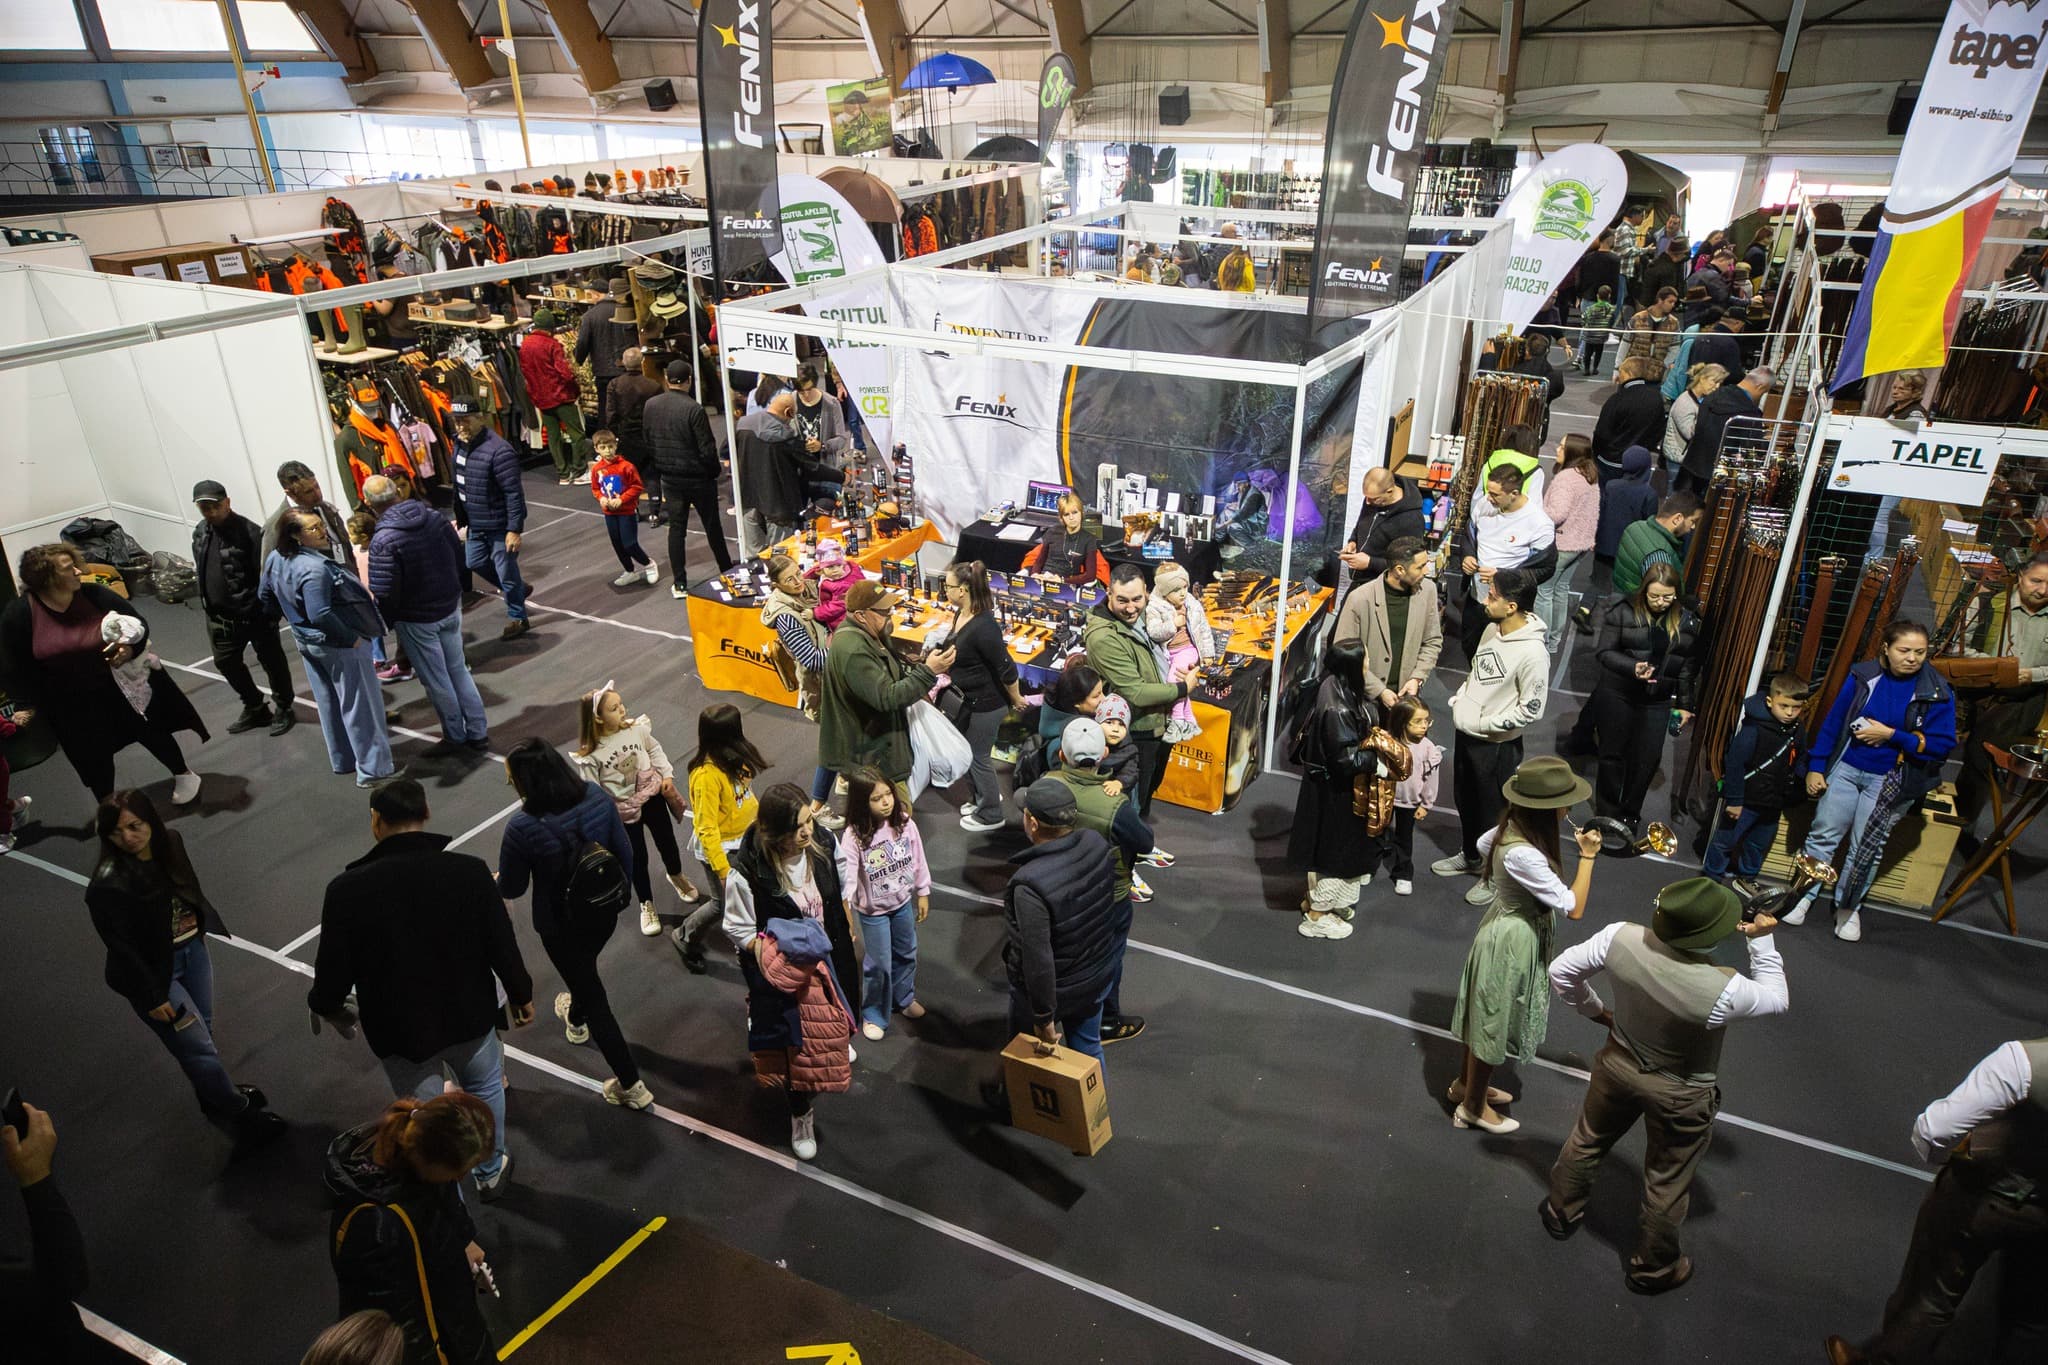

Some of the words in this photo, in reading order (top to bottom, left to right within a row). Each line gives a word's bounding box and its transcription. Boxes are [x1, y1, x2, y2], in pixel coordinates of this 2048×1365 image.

[746, 332, 789, 352] FENIX
[955, 395, 1018, 419] FENIX
[1891, 439, 1985, 470] TAPEL
